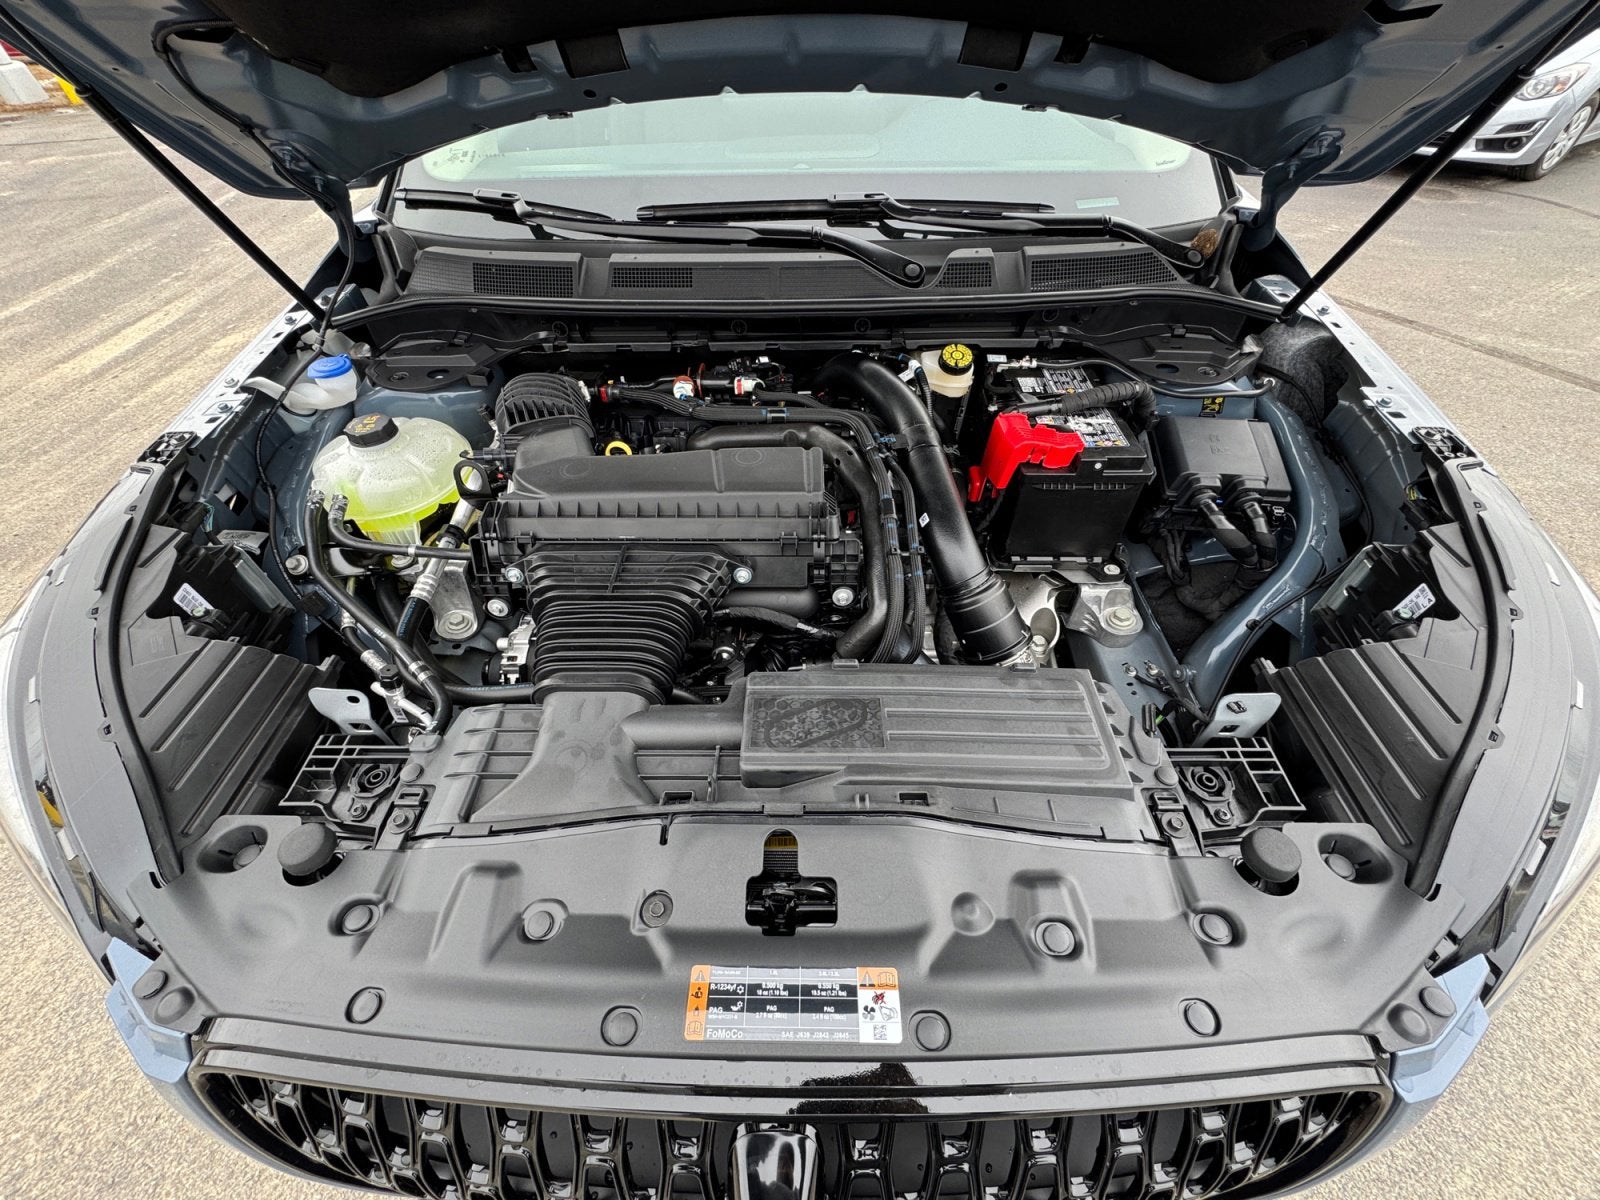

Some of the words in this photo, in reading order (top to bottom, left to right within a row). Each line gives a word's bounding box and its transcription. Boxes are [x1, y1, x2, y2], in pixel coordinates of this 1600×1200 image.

[710, 983, 737, 992] R-1234yf
[777, 982, 784, 991] kg
[833, 983, 840, 991] kg
[709, 1006, 723, 1014] PAG
[707, 1029, 743, 1038] FoMoCo
